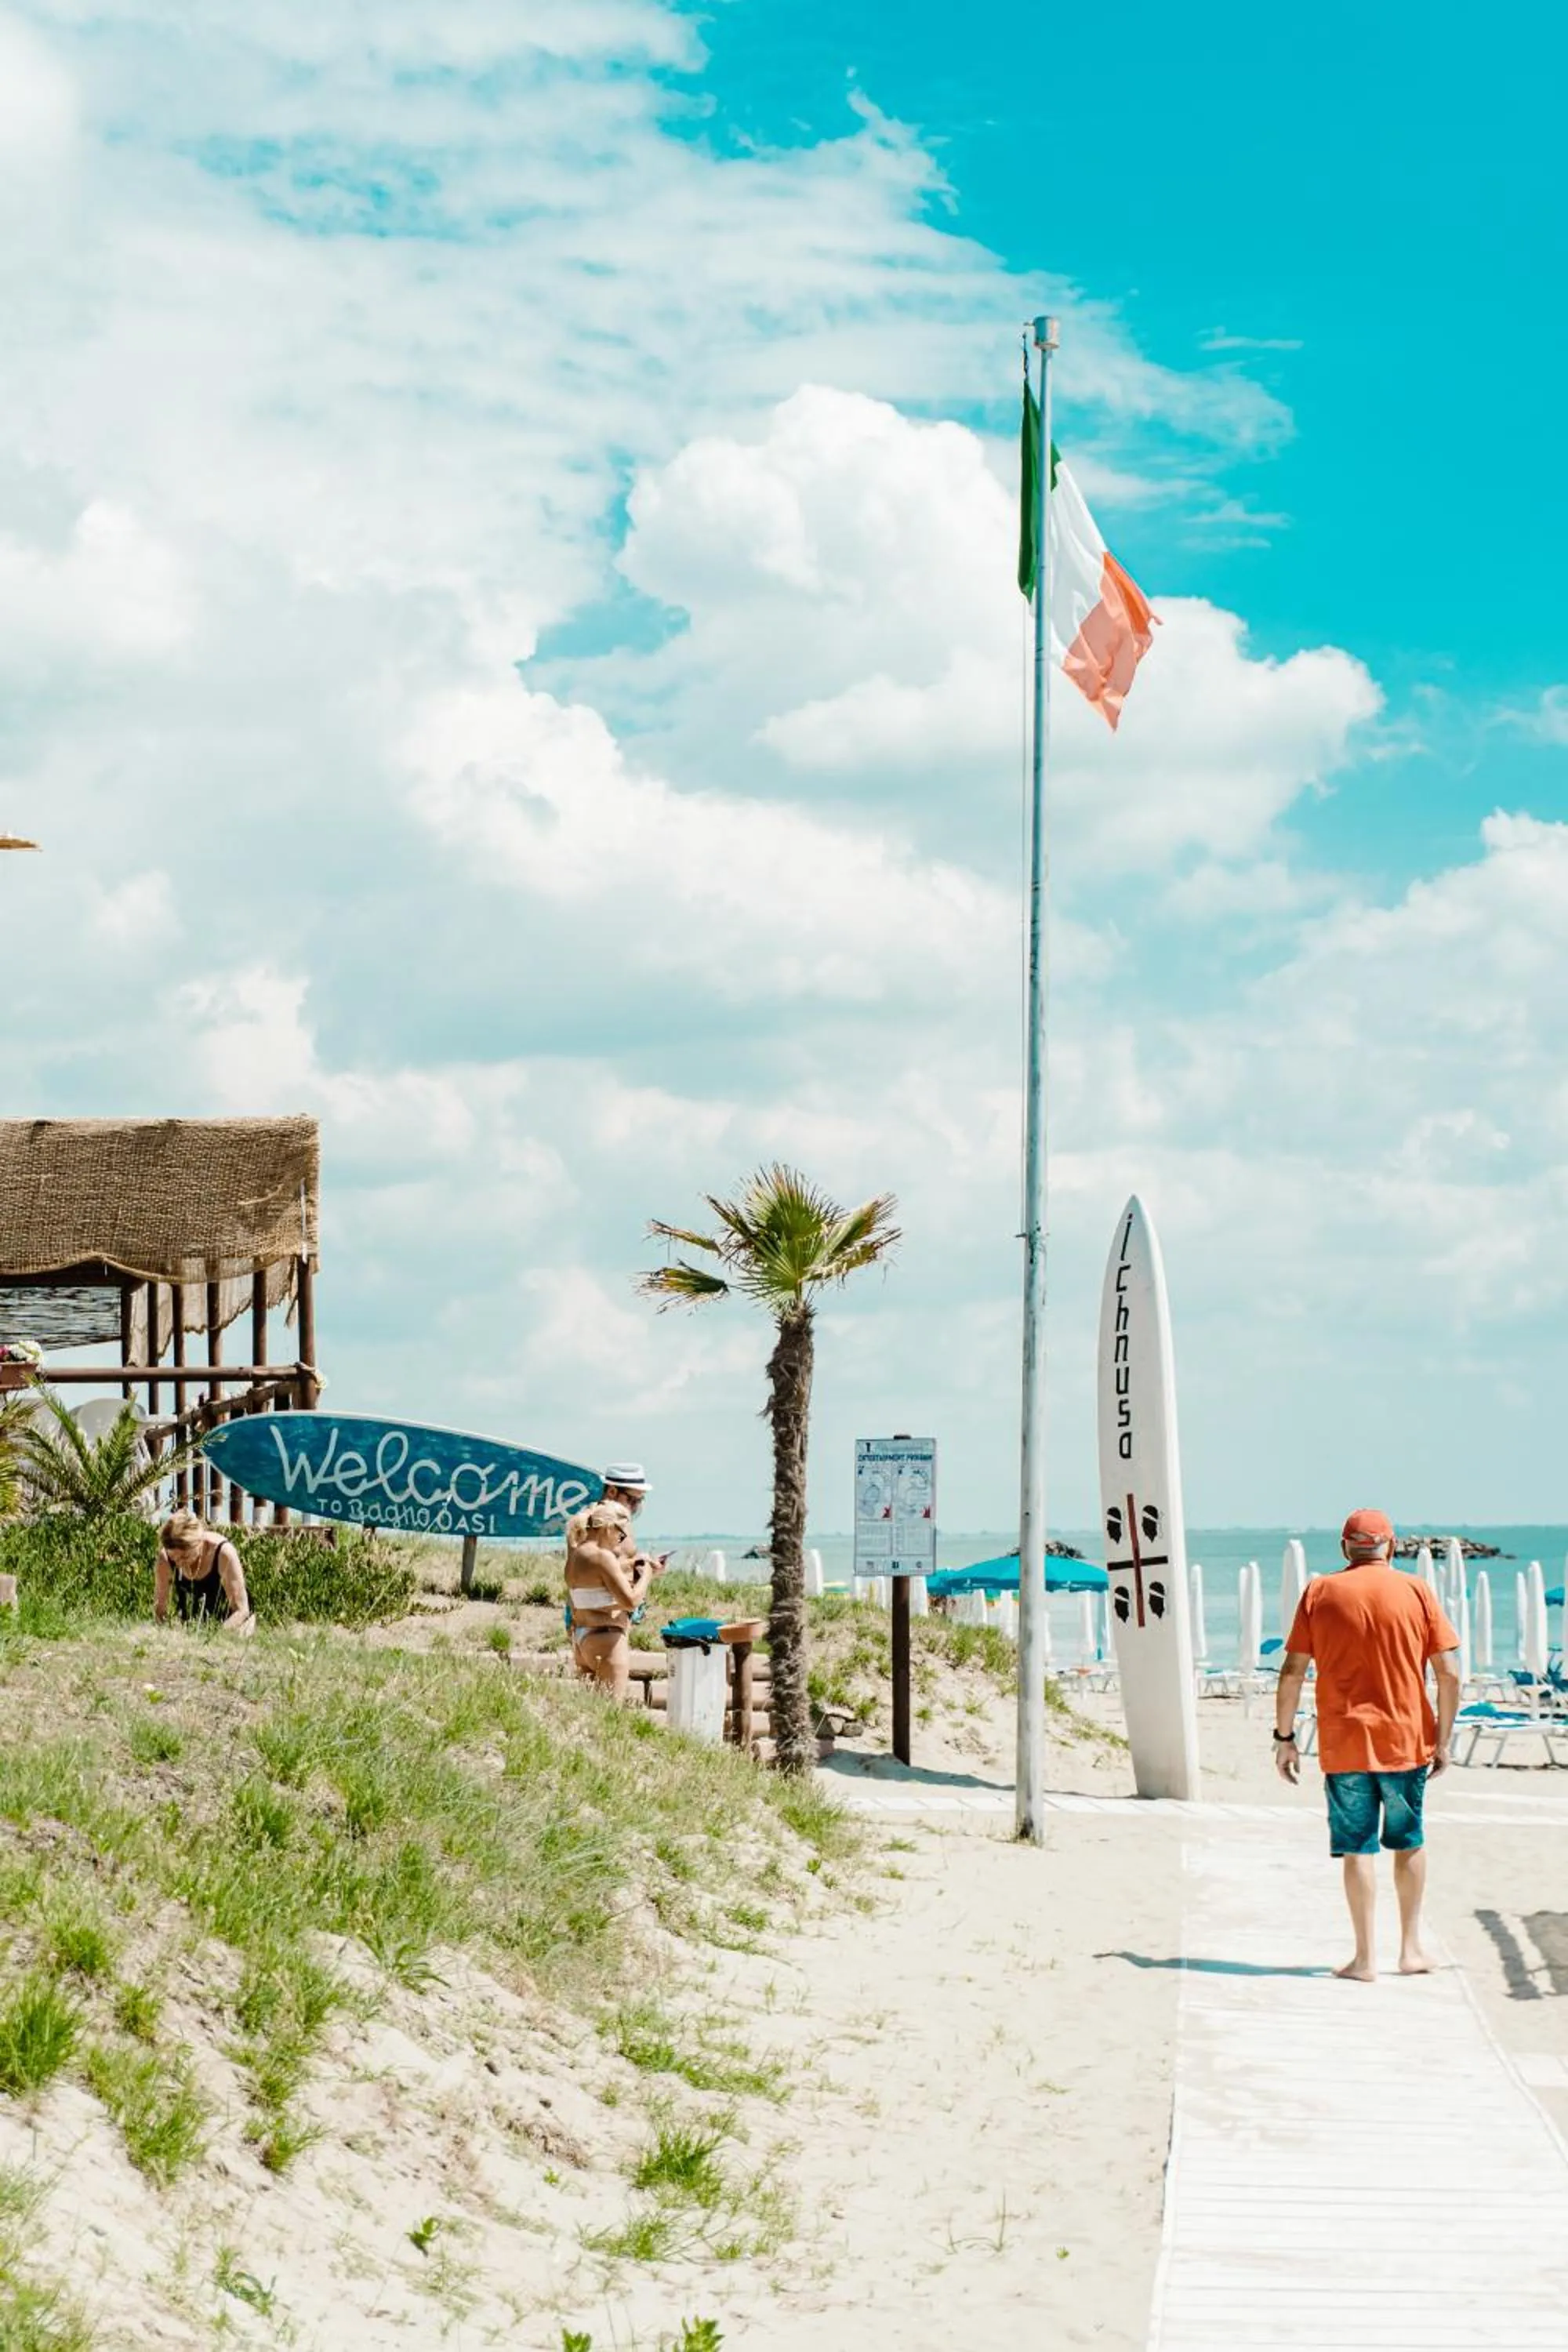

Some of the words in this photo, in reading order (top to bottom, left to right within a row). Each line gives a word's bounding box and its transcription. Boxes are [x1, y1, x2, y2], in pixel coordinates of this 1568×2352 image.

[1114, 1213, 1134, 1460] ichnusa
[270, 1424, 591, 1519] Welcome
[316, 1497, 343, 1514] TO
[347, 1497, 430, 1529] Bagno
[436, 1504, 495, 1534] OASI
